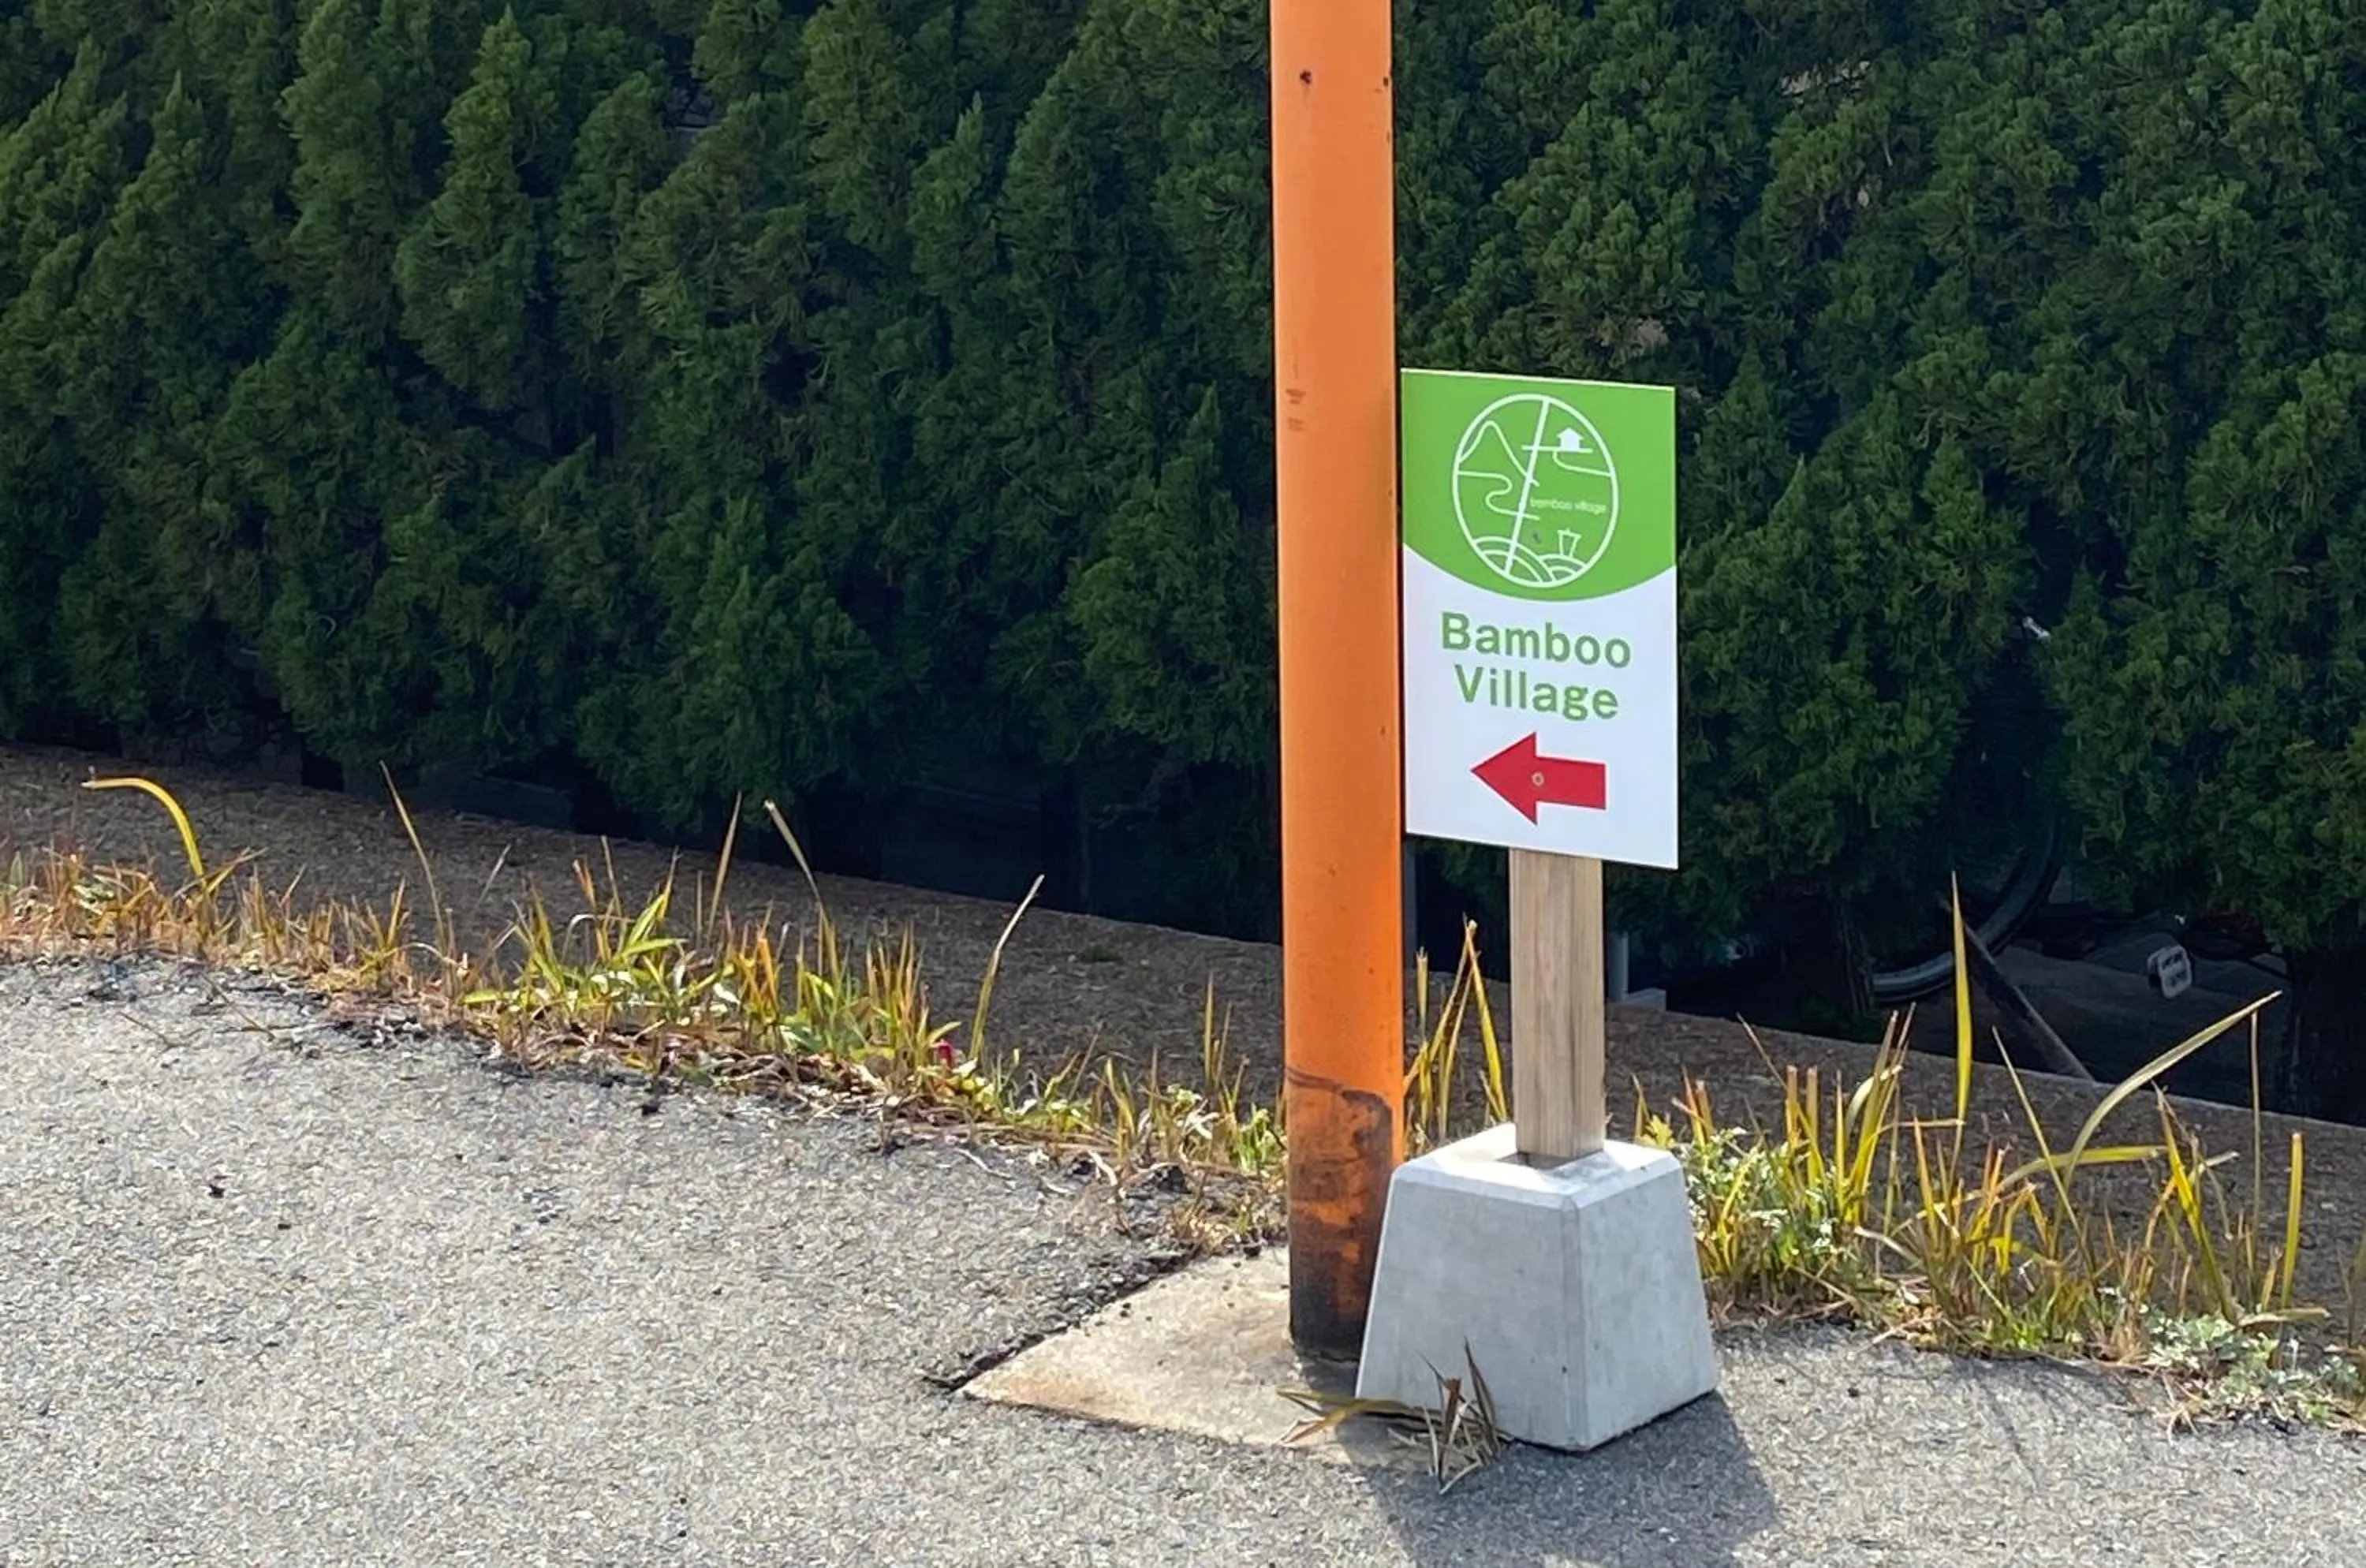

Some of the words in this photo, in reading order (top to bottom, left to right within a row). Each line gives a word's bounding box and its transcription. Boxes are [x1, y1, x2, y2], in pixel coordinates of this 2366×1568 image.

[1530, 498, 1572, 511] bamboo
[1574, 500, 1607, 515] village
[1441, 611, 1631, 669] Bamboo
[1454, 663, 1619, 721] Village
